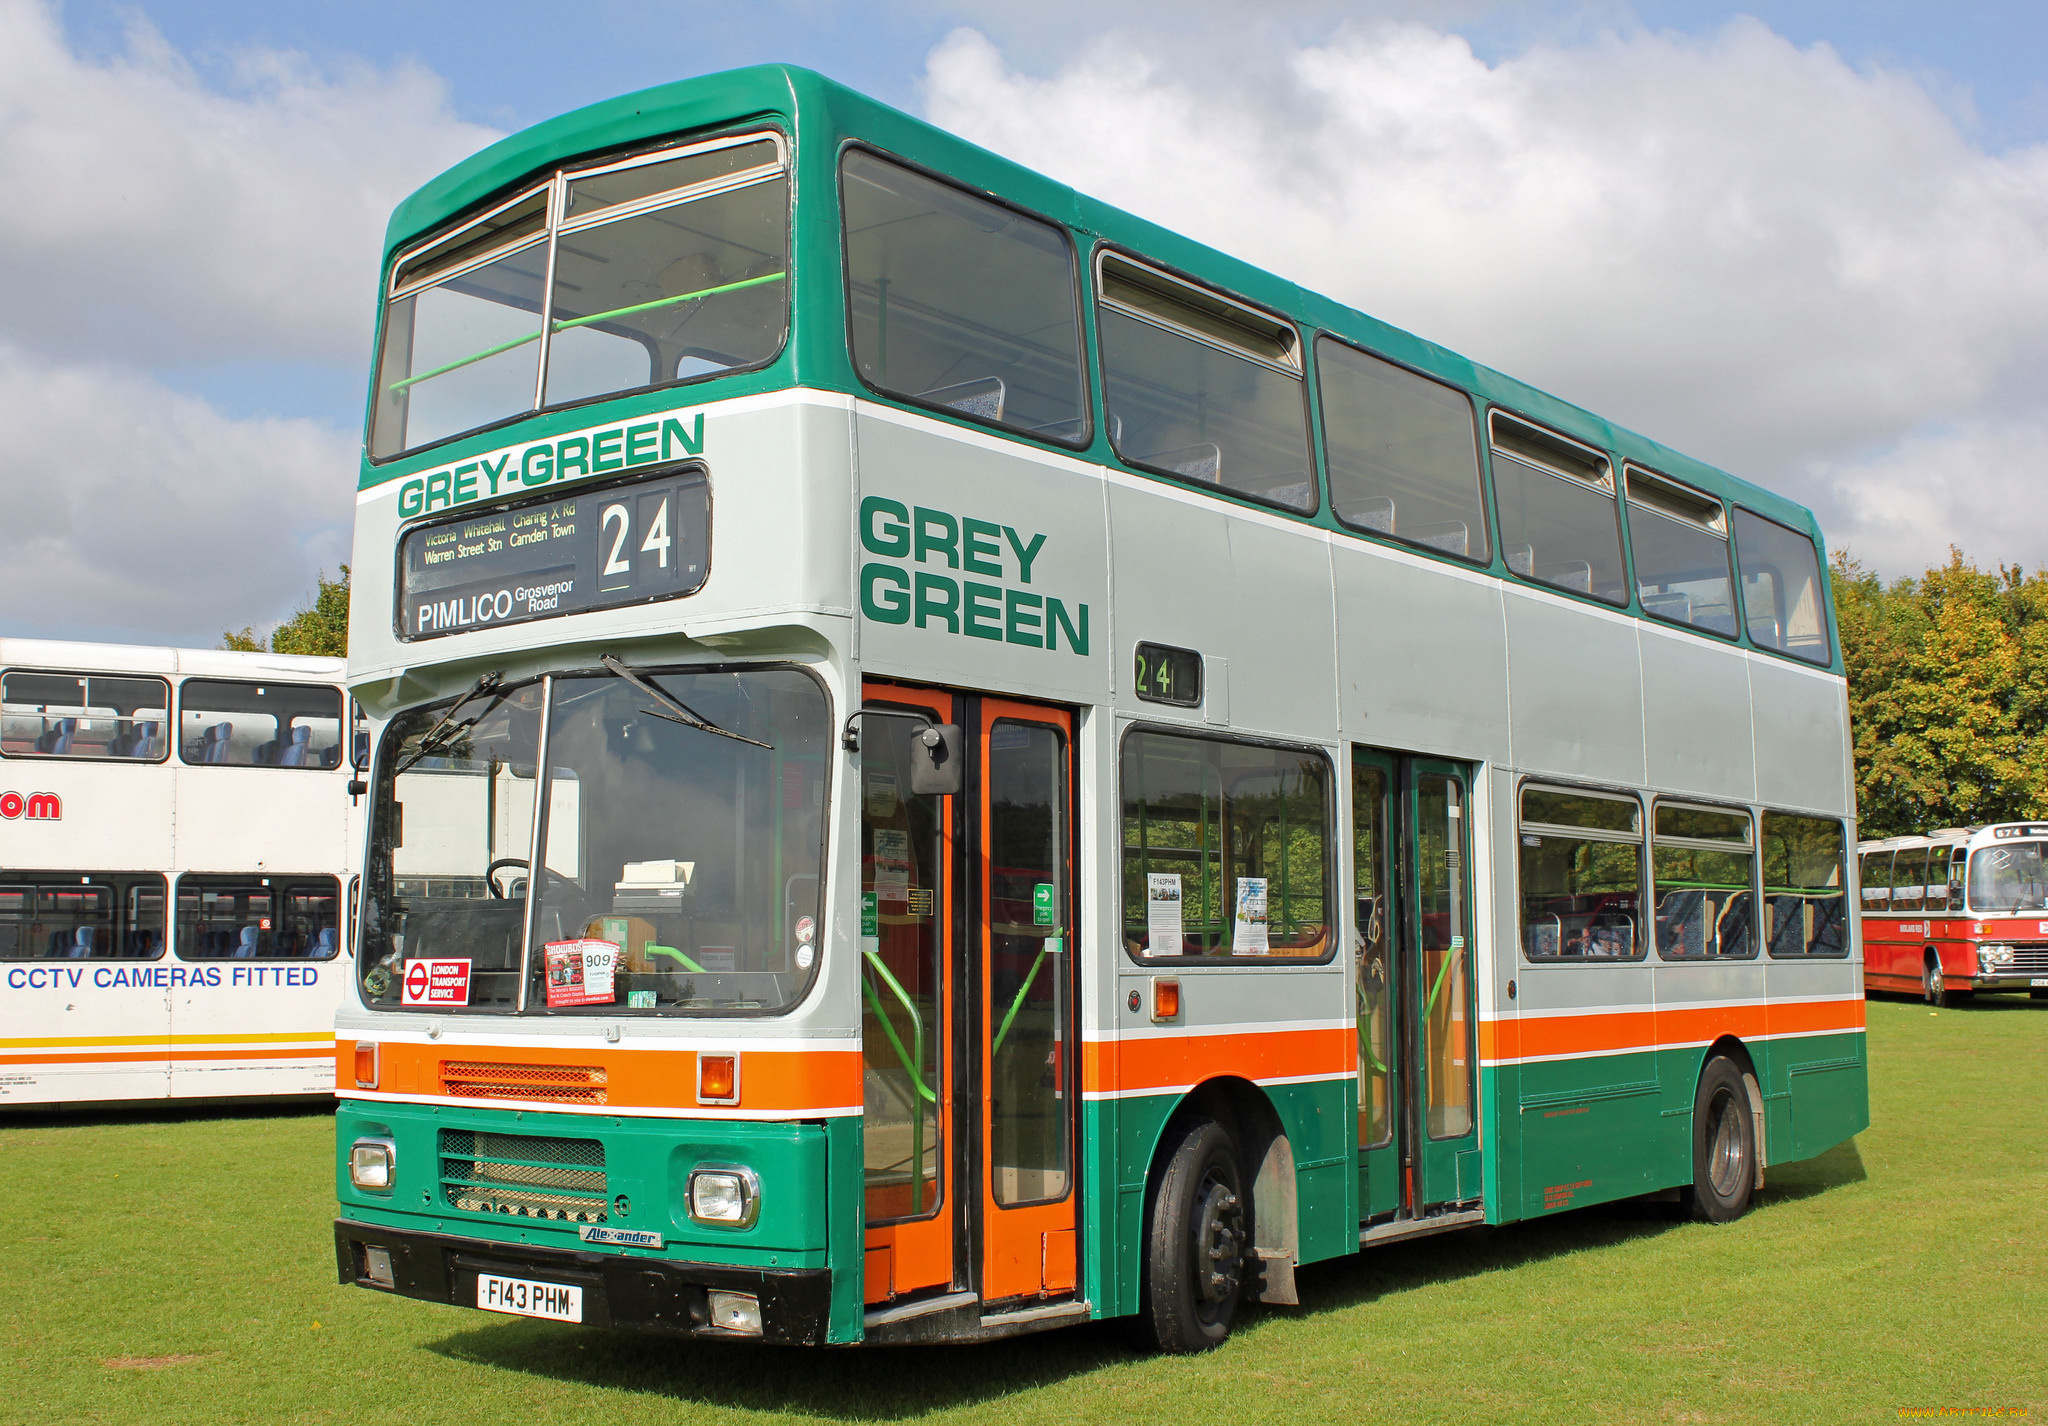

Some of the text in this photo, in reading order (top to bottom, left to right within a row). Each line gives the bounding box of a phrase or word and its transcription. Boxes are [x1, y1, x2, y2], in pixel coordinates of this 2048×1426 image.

[397, 413, 705, 518] GREY-GREEN
[425, 502, 576, 547] Victoria Whitehall Charing X Rd
[602, 497, 671, 576] 24
[424, 523, 575, 565] Warren Street Stn Camden Town
[860, 495, 1047, 584] GREY
[514, 580, 573, 602] Grosvenor
[528, 594, 559, 613] Road
[418, 589, 513, 632] PIMLICO
[860, 562, 1089, 657] GREEN
[1136, 655, 1171, 694] 24
[546, 942, 583, 955] SHOWBUS
[586, 954, 611, 968] 909
[8, 967, 319, 988] CCTV CAMERAS FITTED
[431, 977, 466, 987] TRANSPORT
[432, 965, 459, 975] LONDON
[430, 989, 454, 998] SERVICE
[585, 1227, 656, 1245] Alexander
[488, 1279, 569, 1315] F143 PHM
